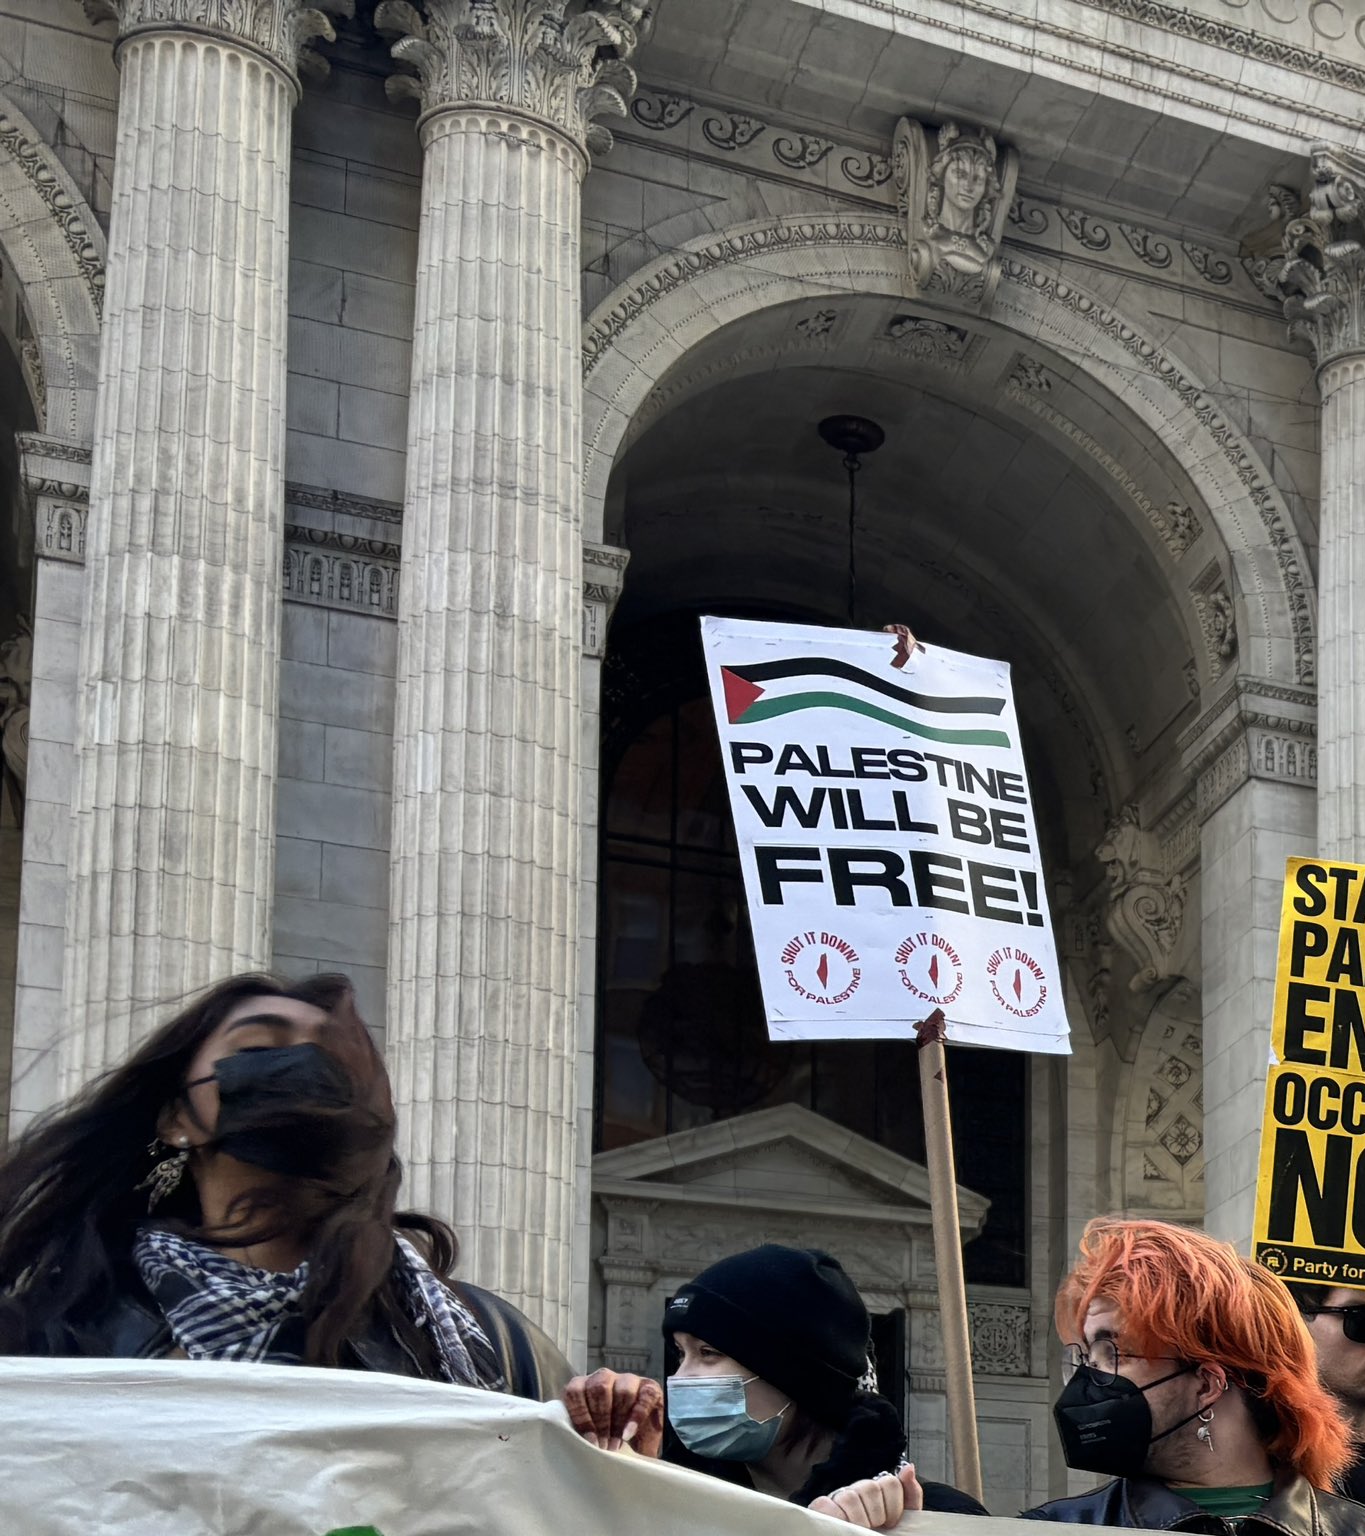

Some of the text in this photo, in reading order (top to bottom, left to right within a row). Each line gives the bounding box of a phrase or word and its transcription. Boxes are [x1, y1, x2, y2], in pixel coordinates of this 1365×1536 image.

[730, 741, 1026, 804] PALESTINE
[740, 785, 1030, 853] WILL BE
[754, 846, 1044, 927] FREE!
[781, 931, 859, 965] SHUT IT DOWN!
[895, 932, 962, 967] SHUT IT DOWN!
[987, 947, 1045, 980] SHUT IT DOWN!
[784, 968, 860, 1004] FOR PALESTINE
[898, 969, 963, 1005] FOR PALESTINE
[989, 980, 1046, 1017] FOR PALESTINE
[1293, 1258, 1336, 1279] Party
[1342, 1263, 1365, 1280] for
